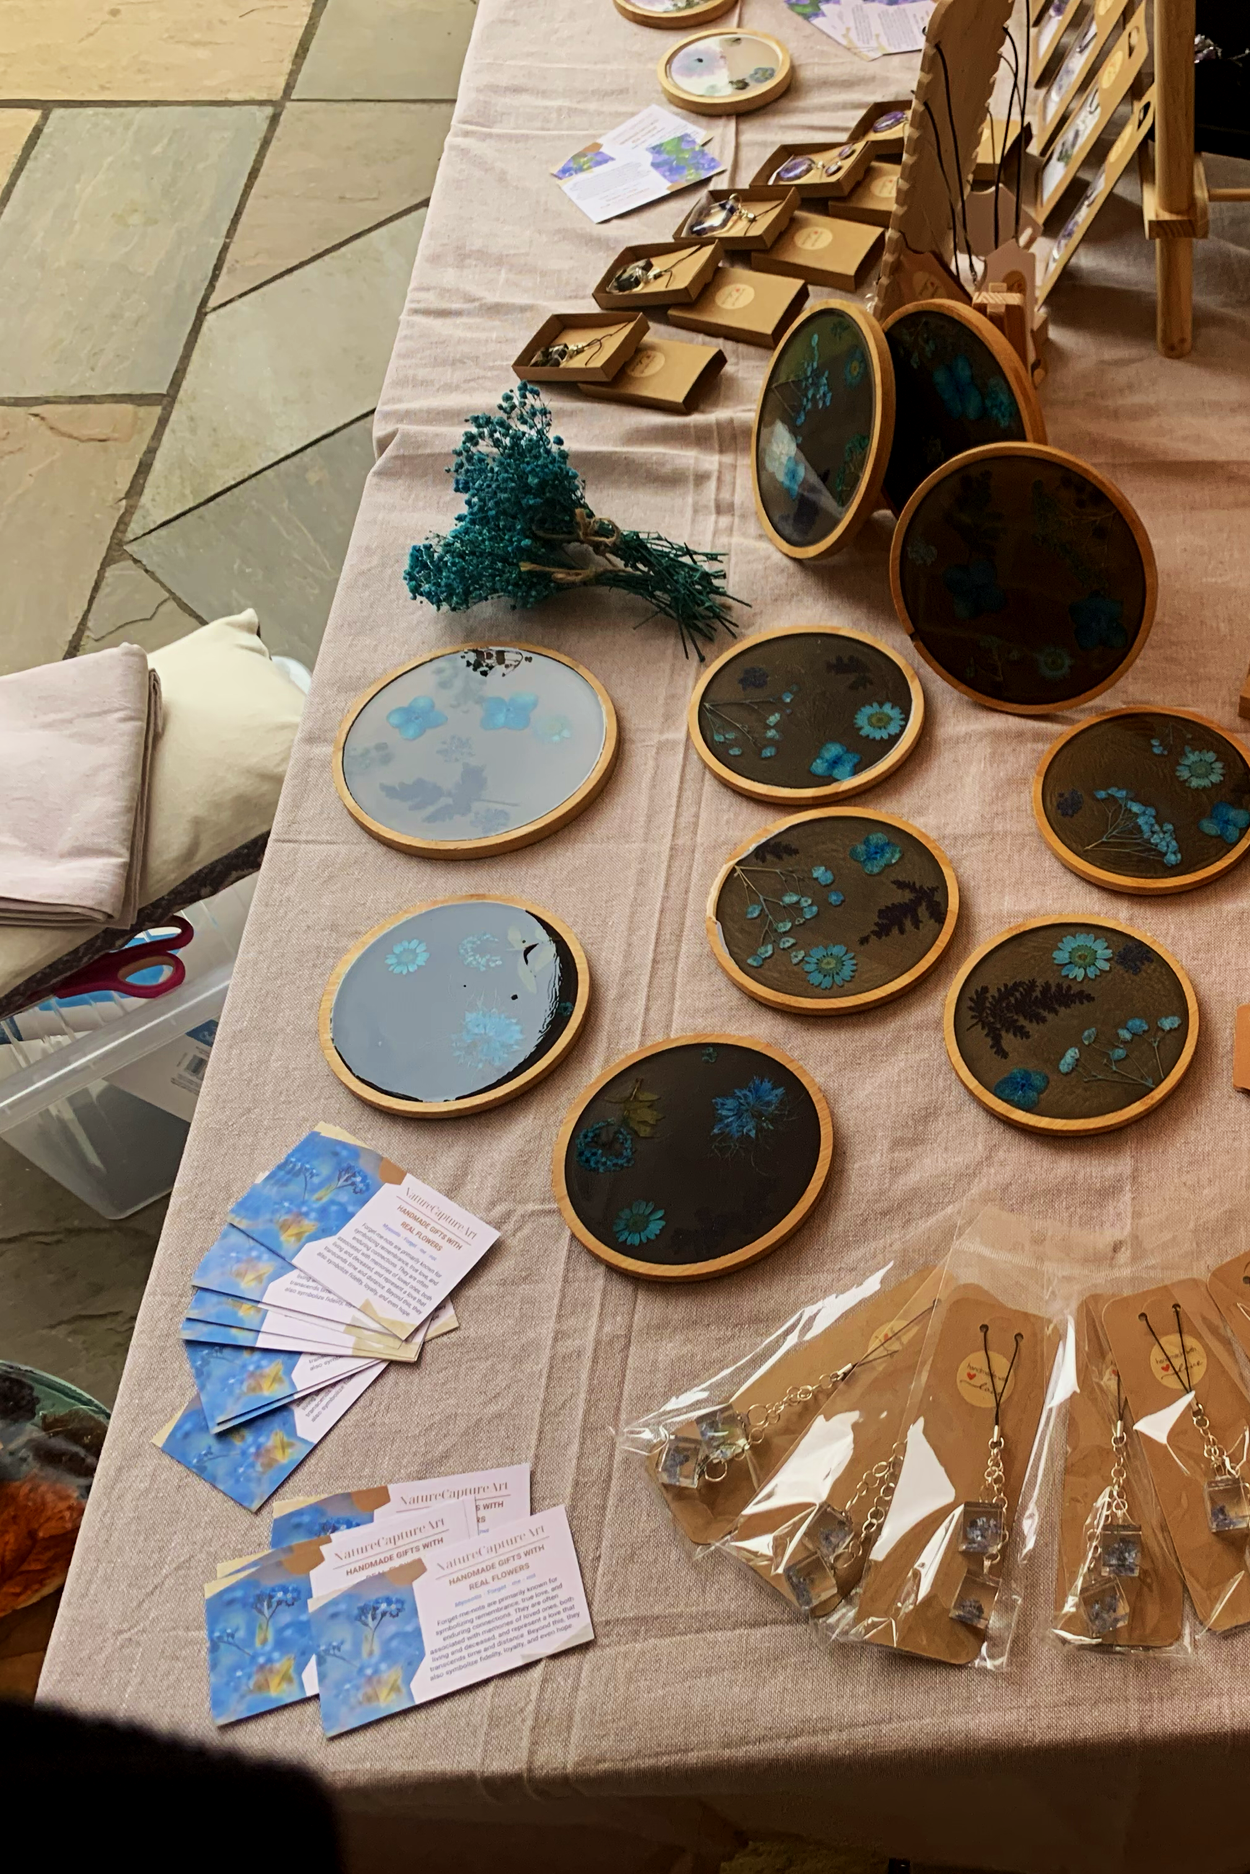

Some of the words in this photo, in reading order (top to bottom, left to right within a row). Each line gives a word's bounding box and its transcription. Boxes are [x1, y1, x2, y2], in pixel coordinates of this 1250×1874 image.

[396, 1204, 430, 1229] HANDMADE
[428, 1225, 448, 1240] GIFTS
[445, 1236, 463, 1250] WITH
[399, 1221, 417, 1234] REAL
[414, 1230, 443, 1251] FLOWERS
[402, 1187, 479, 1240] NatureCaptureArt
[400, 1482, 508, 1505] NatureCaptureArt
[483, 1501, 504, 1510] WITH
[334, 1517, 445, 1561] NatureCaptureArt
[346, 1554, 394, 1576] HANDMADE
[396, 1545, 420, 1560] GIFTS
[422, 1537, 444, 1550] WITH
[436, 1523, 544, 1572] NatureCaptureArt
[448, 1561, 496, 1585] HANDMADE
[497, 1552, 521, 1566] GIFTS
[523, 1542, 545, 1557] WITH
[468, 1577, 489, 1590] REAL
[491, 1561, 529, 1582] FLOWERS
[435, 1617, 473, 1635] symbolizing
[521, 1594, 533, 1602] true
[550, 1582, 562, 1591] and
[498, 1589, 525, 1604] primarily
[526, 1581, 547, 1592] known
[429, 1636, 465, 1654] associated
[466, 1630, 480, 1640] with
[481, 1619, 513, 1635] memories
[522, 1608, 540, 1619] loved
[559, 1595, 574, 1605] both
[431, 1652, 449, 1662] living
[450, 1646, 462, 1655] and
[498, 1628, 510, 1637] and
[511, 1616, 541, 1632] represent
[548, 1610, 561, 1618] love
[562, 1603, 575, 1612] that
[442, 1626, 471, 1640] enduring
[514, 1604, 529, 1613] They
[542, 1593, 558, 1603] often
[429, 1655, 465, 1672] transcends
[467, 1648, 481, 1657] time
[483, 1642, 495, 1651] and
[526, 1621, 550, 1635] Beyond
[566, 1611, 580, 1620] they
[430, 1672, 443, 1680] also
[445, 1659, 478, 1675] symbolize
[526, 1634, 538, 1644] and
[539, 1630, 555, 1639] even
